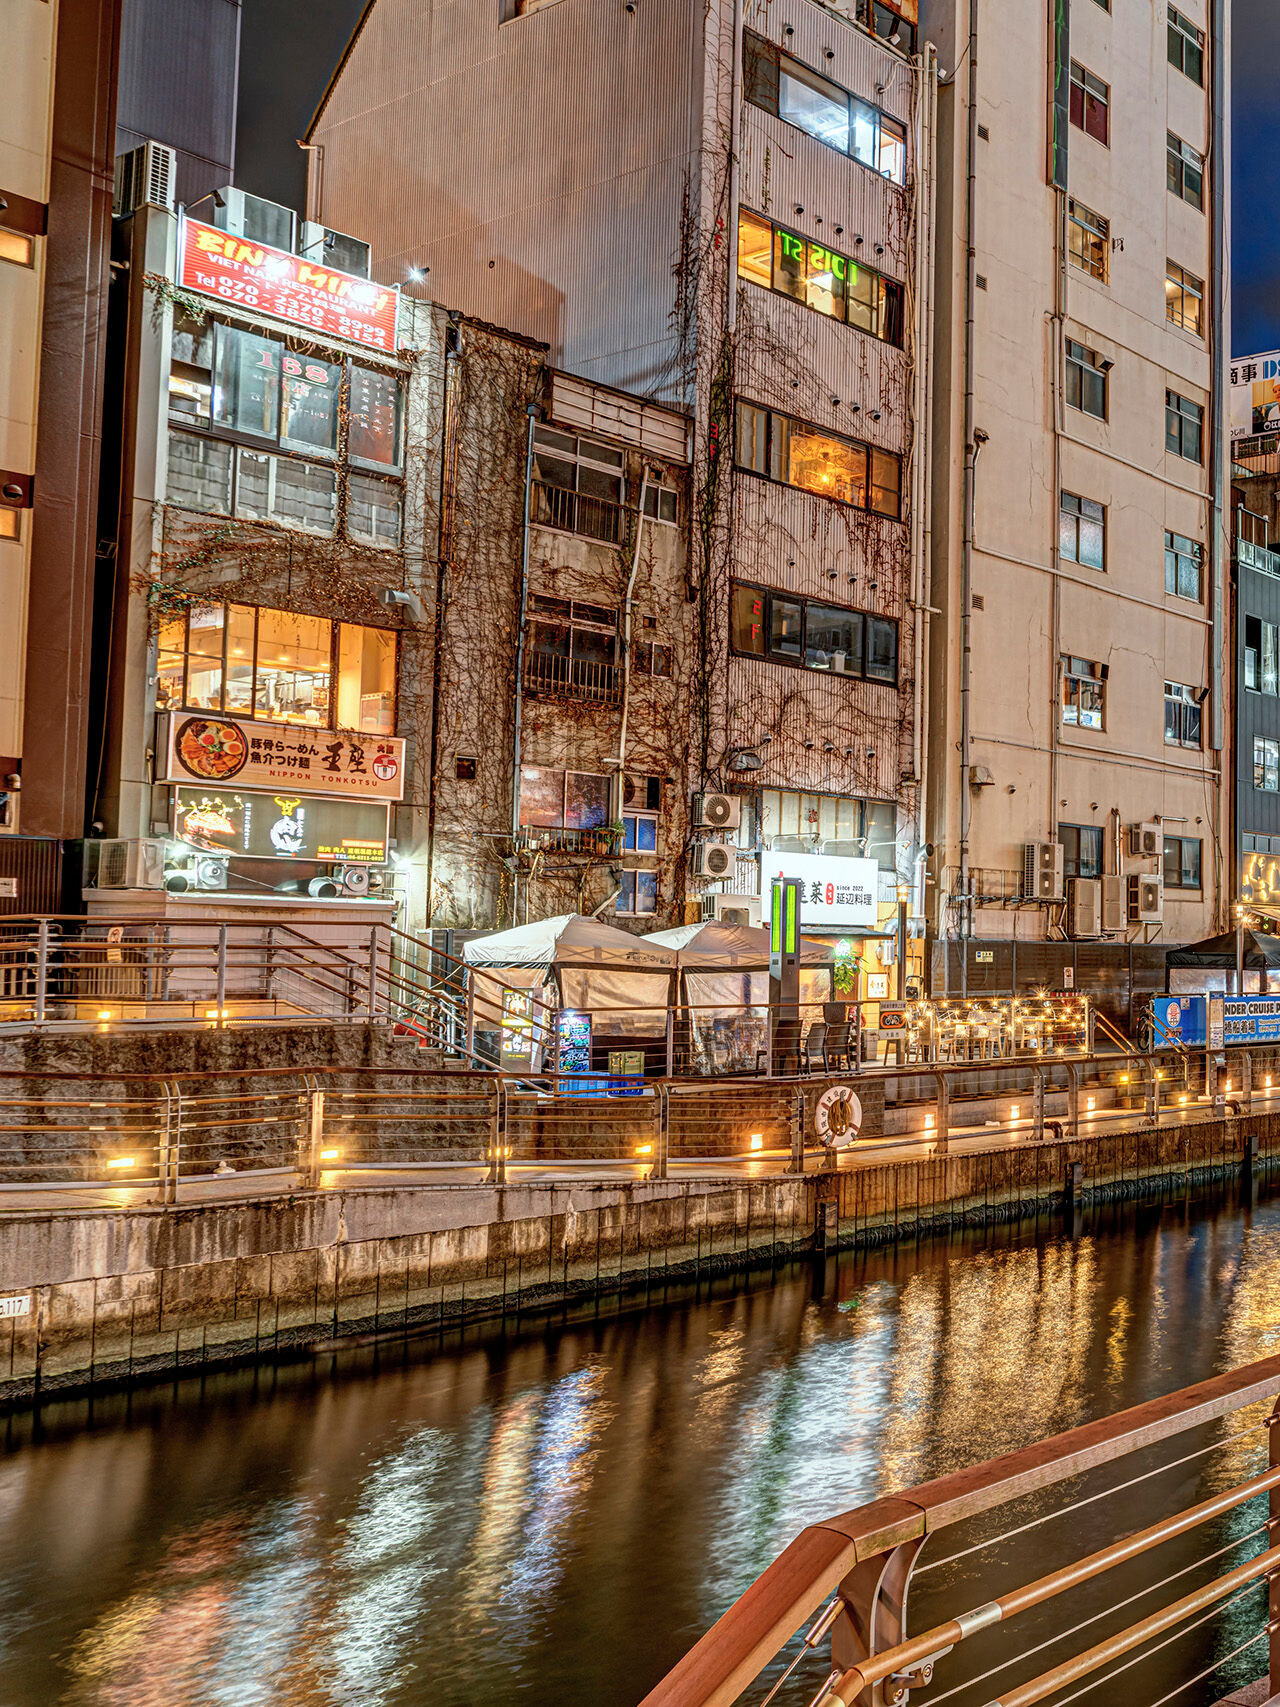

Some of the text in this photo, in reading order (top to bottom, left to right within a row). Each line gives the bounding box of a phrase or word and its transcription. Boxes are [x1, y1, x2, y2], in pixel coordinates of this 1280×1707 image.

[194, 271, 216, 289] Tel
[207, 252, 377, 317] VIET NAM RESTAURANT
[250, 751, 311, 769] 魚介つけ麺
[269, 770, 378, 787] NIPPON TONKOTSU
[1248, 1002, 1274, 1015] CRUISE
